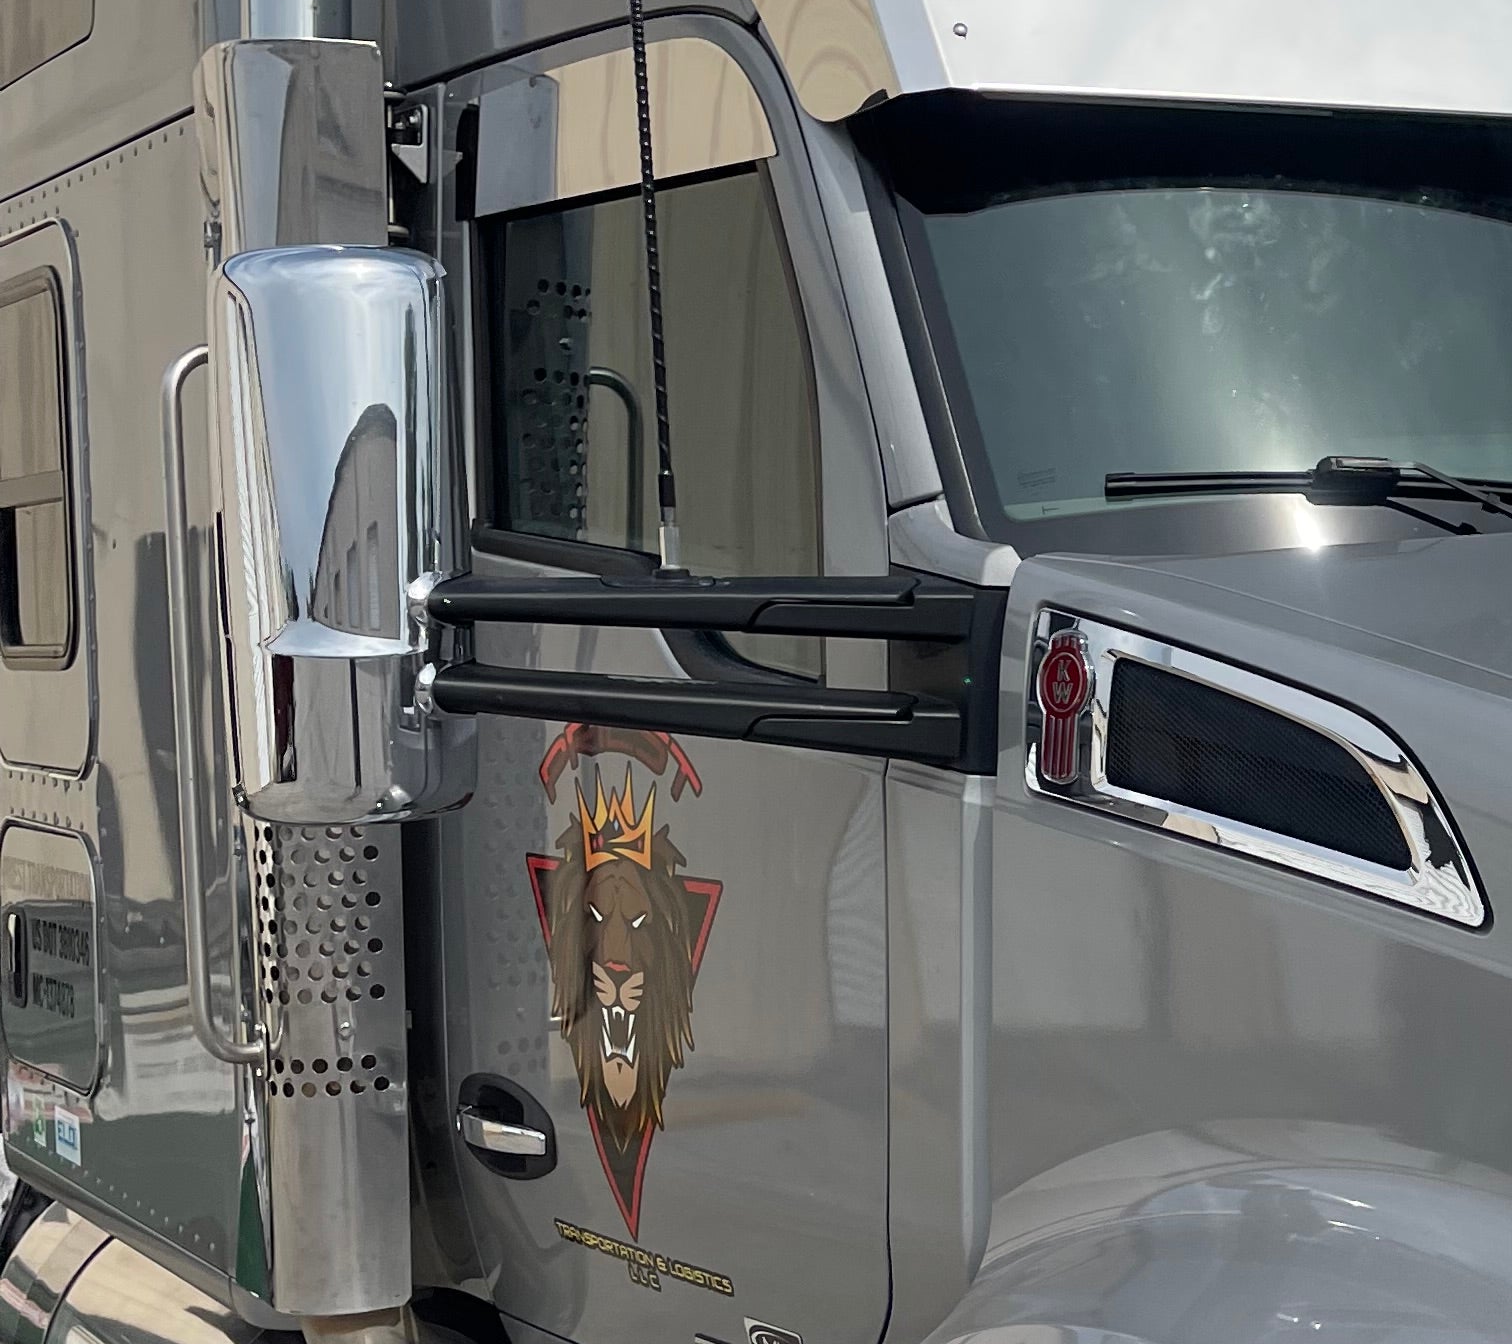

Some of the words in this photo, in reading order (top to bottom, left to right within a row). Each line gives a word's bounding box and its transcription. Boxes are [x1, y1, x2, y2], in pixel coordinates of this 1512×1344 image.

[555, 1221, 655, 1268] TRANSPORTATION
[655, 1256, 668, 1273] &
[668, 1259, 733, 1294] LOGISTICS
